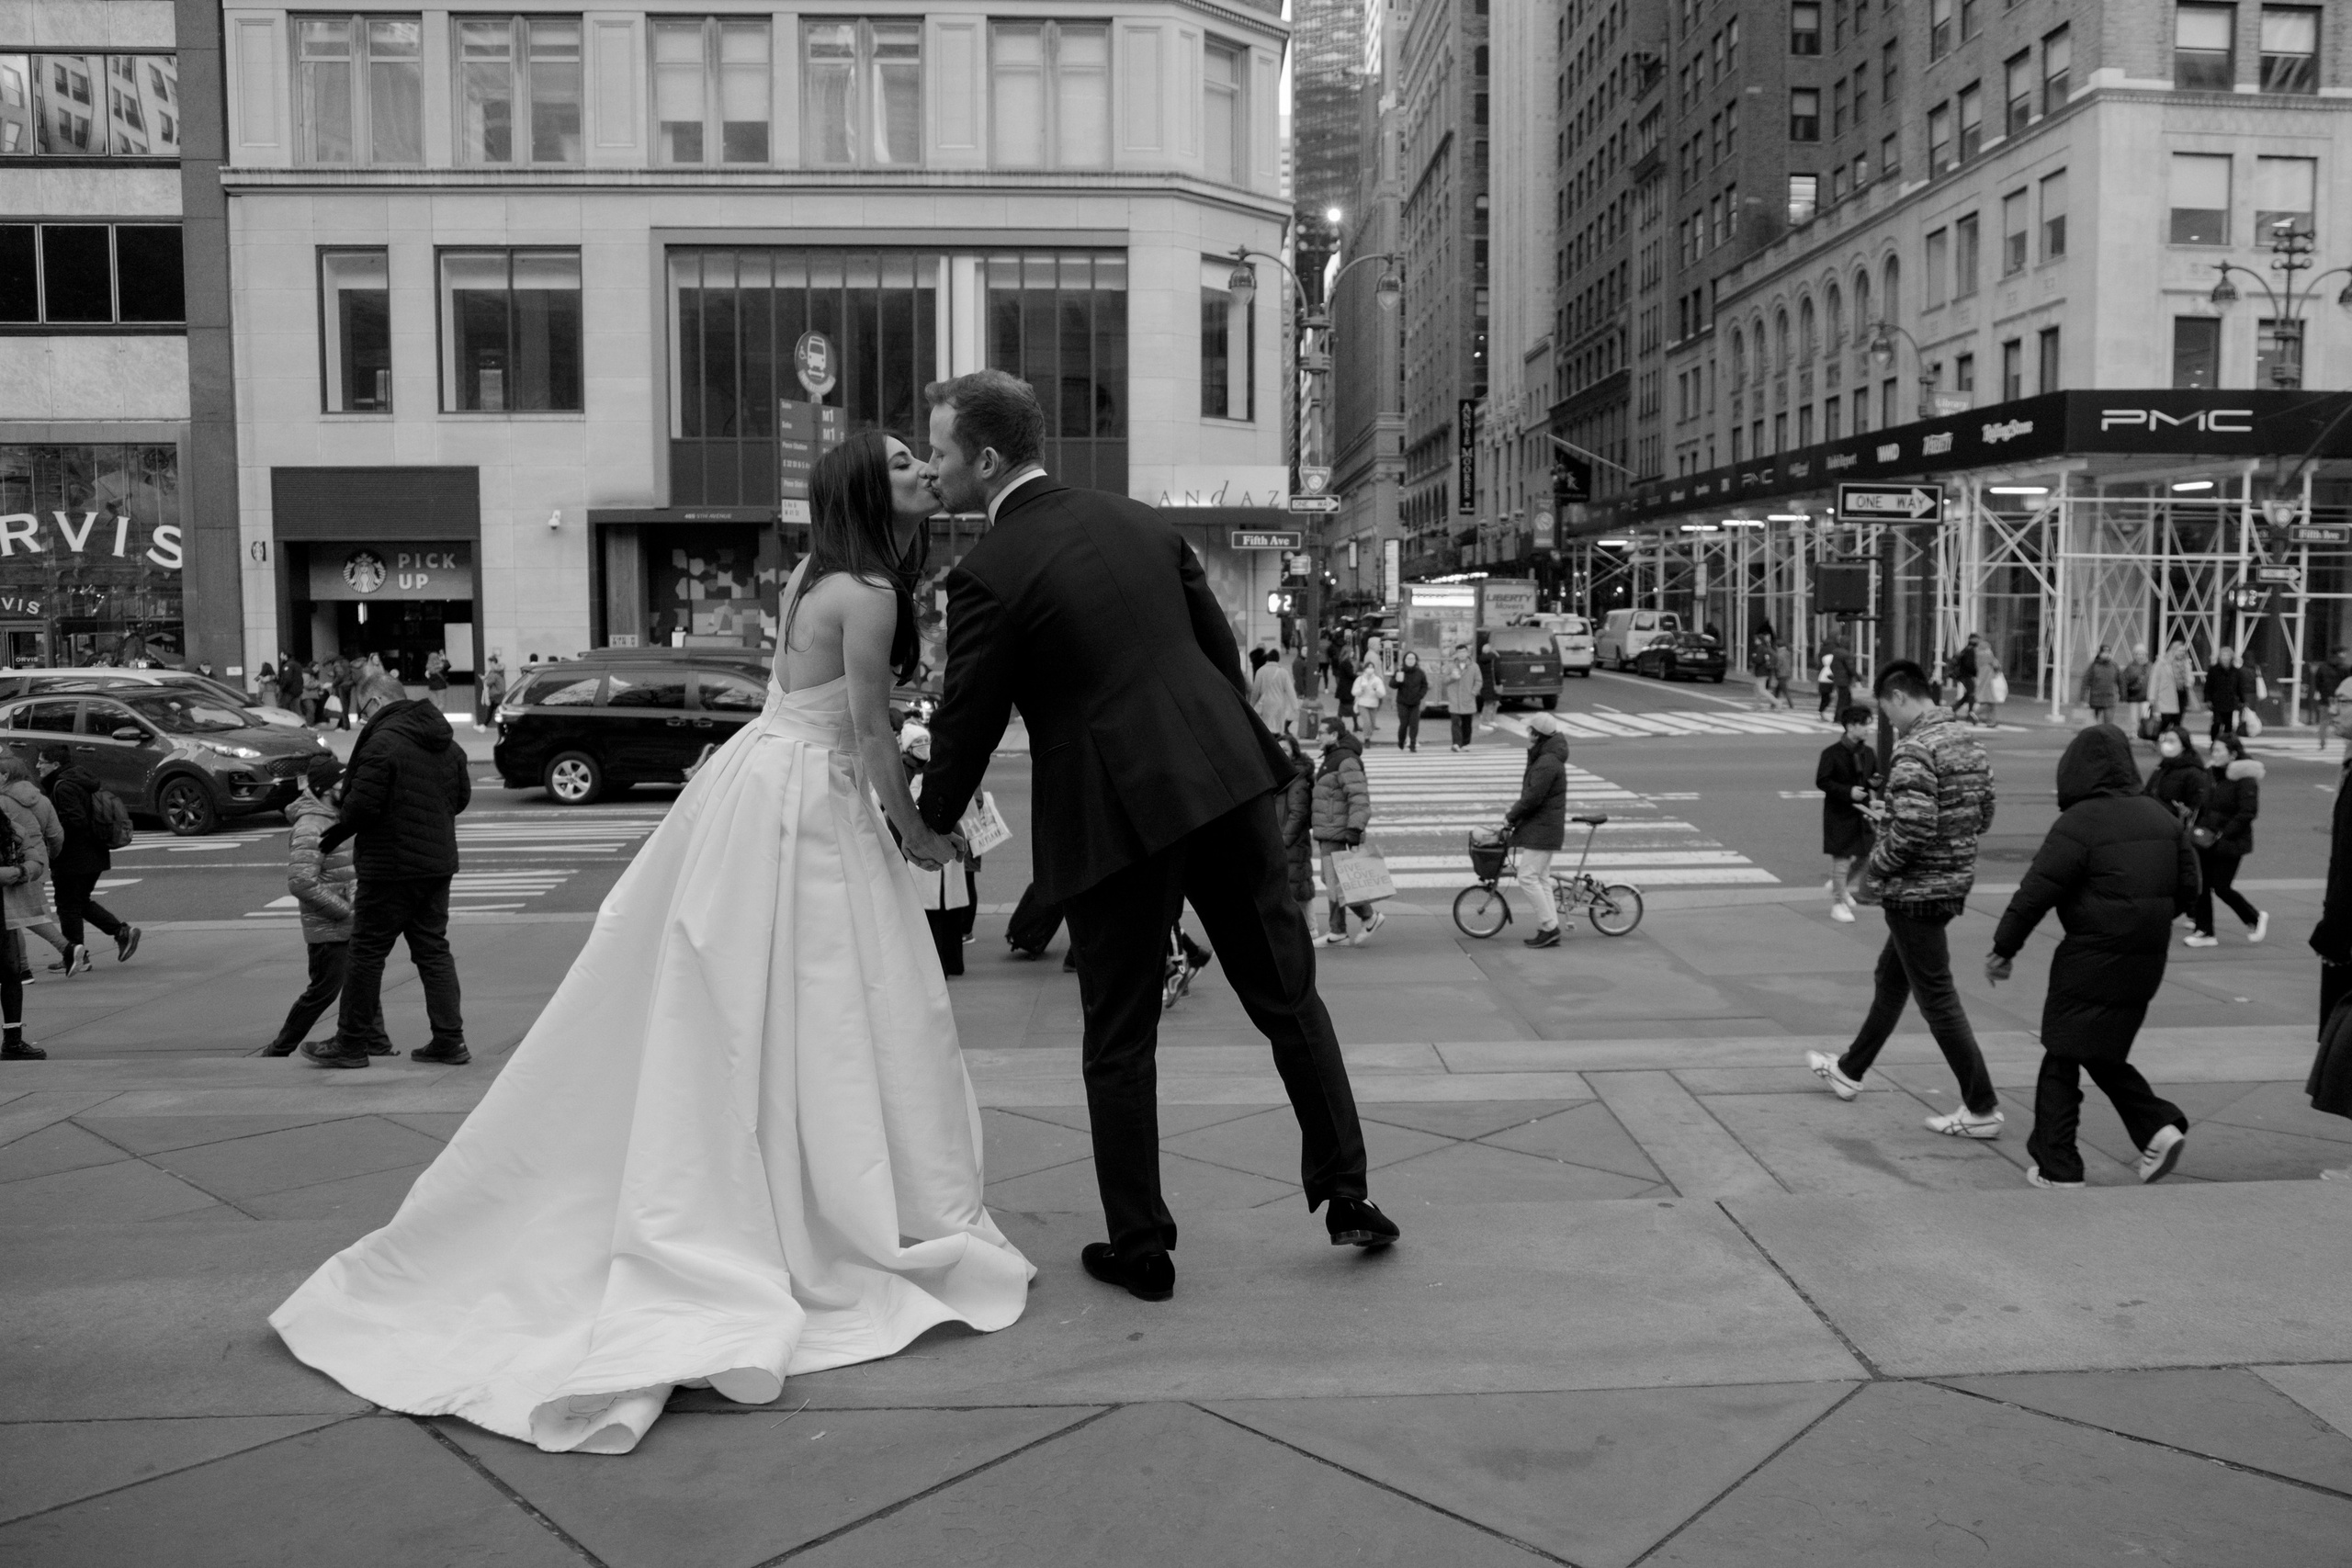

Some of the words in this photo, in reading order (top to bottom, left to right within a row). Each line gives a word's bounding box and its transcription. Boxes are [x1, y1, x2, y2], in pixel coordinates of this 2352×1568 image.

[821, 409, 833, 423] M1
[2100, 409, 2254, 433] PMC
[1462, 401, 1473, 446] ANNIE
[822, 427, 835, 441] M1
[1857, 495, 1883, 509] ONE
[1897, 496, 1926, 510] WAY
[1242, 535, 1268, 546] Fifth
[1270, 536, 1290, 546] Ave
[398, 553, 456, 569] PICK
[398, 573, 429, 590] UP
[1486, 593, 1532, 602] LIBERTY
[15, 655, 39, 663] ORVIS
